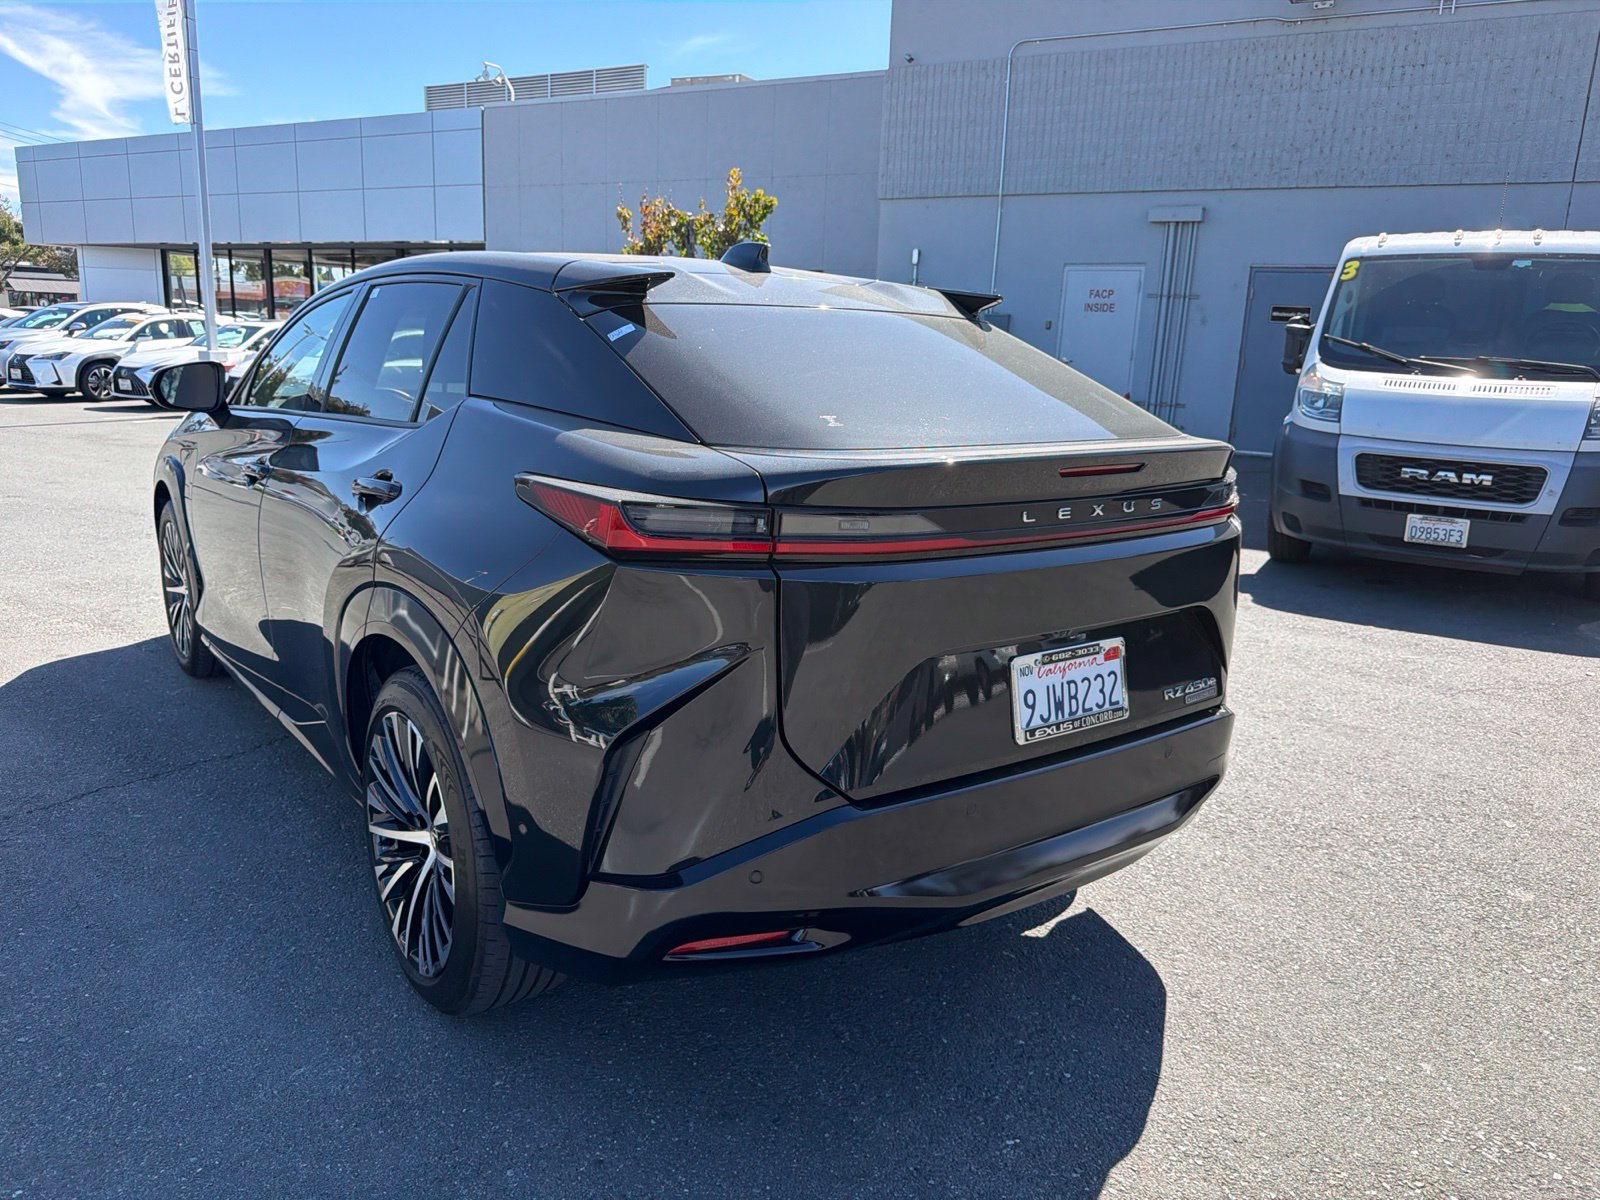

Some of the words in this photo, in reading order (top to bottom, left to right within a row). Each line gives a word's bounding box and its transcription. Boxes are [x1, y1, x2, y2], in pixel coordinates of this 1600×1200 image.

[1088, 289, 1115, 299] FACP
[1083, 303, 1116, 313] INSIDE
[1400, 467, 1494, 486] RAM
[1022, 498, 1163, 523] LEXUS
[1409, 525, 1464, 543] 09853F3
[1019, 664, 1034, 678] NOV
[1037, 656, 1104, 680] California
[1163, 685, 1185, 701] RZ
[1185, 677, 1217, 694] 450e
[1023, 670, 1120, 728] 9JWB232
[1026, 721, 1073, 740] LEXUS
